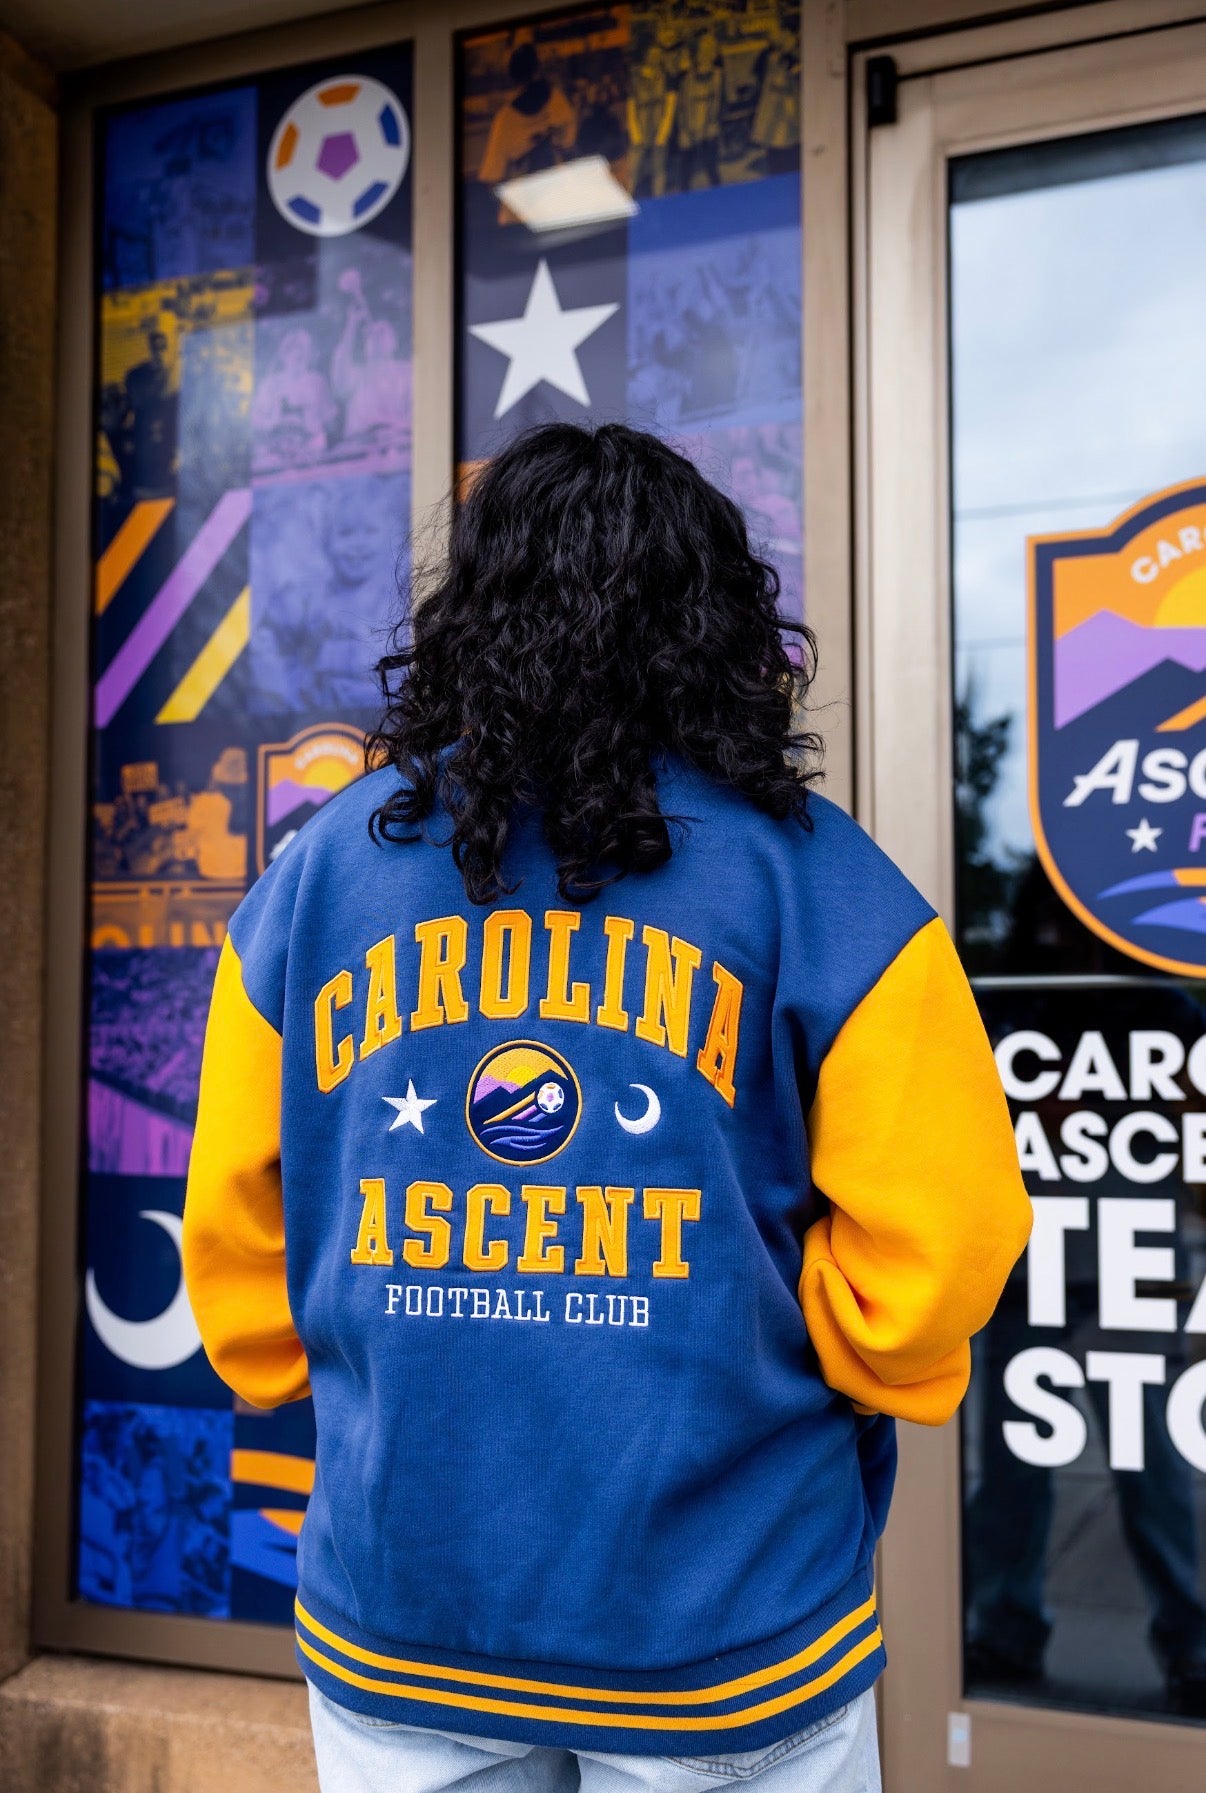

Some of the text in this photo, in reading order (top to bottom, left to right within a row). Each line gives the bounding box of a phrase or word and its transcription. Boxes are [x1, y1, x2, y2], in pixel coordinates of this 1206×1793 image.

[1131, 525, 1206, 584] CAR
[314, 909, 744, 1109] CAROLINA
[994, 1030, 1206, 1101] CAR
[350, 1178, 702, 1279] ASCENT
[1028, 1196, 1206, 1334] TE
[384, 1284, 649, 1327] FOOTBALL CLUB
